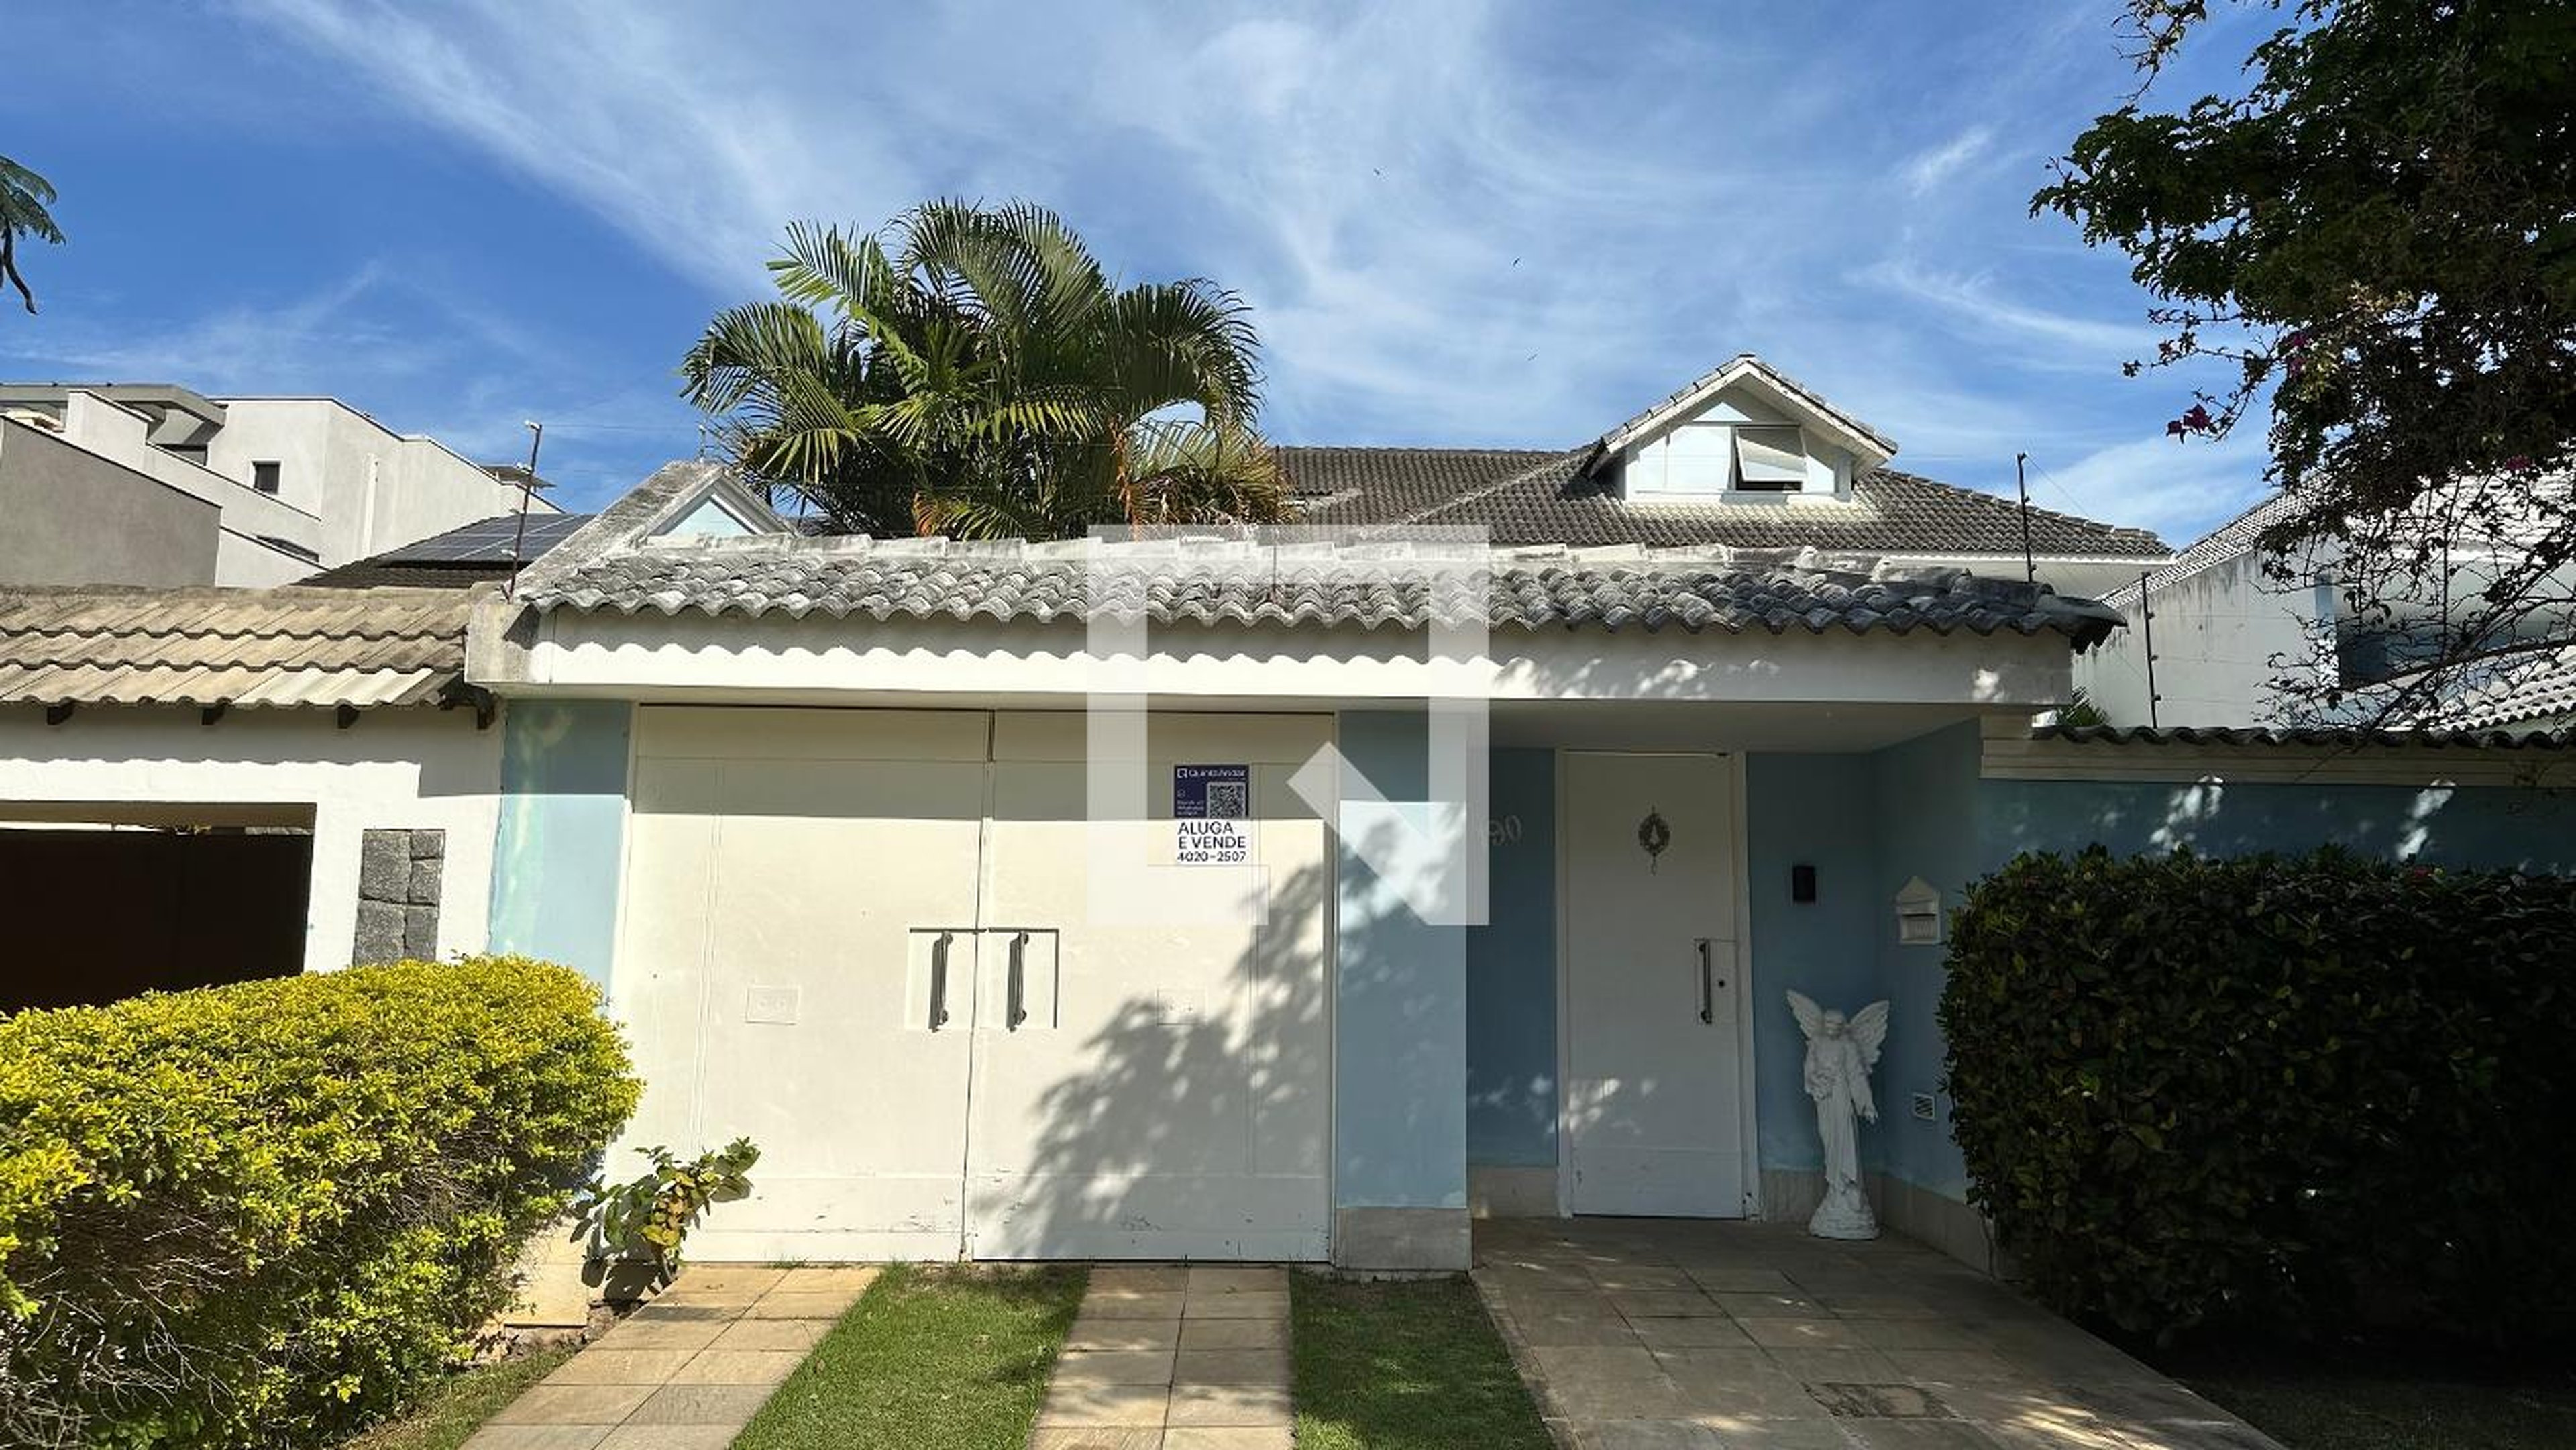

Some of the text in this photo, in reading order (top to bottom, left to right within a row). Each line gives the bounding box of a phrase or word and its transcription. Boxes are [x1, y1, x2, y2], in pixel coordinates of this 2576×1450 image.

[1177, 821, 1234, 835] ALUGA
[1179, 836, 1246, 849] E VENDE
[1177, 851, 1246, 862] 4020-2507
